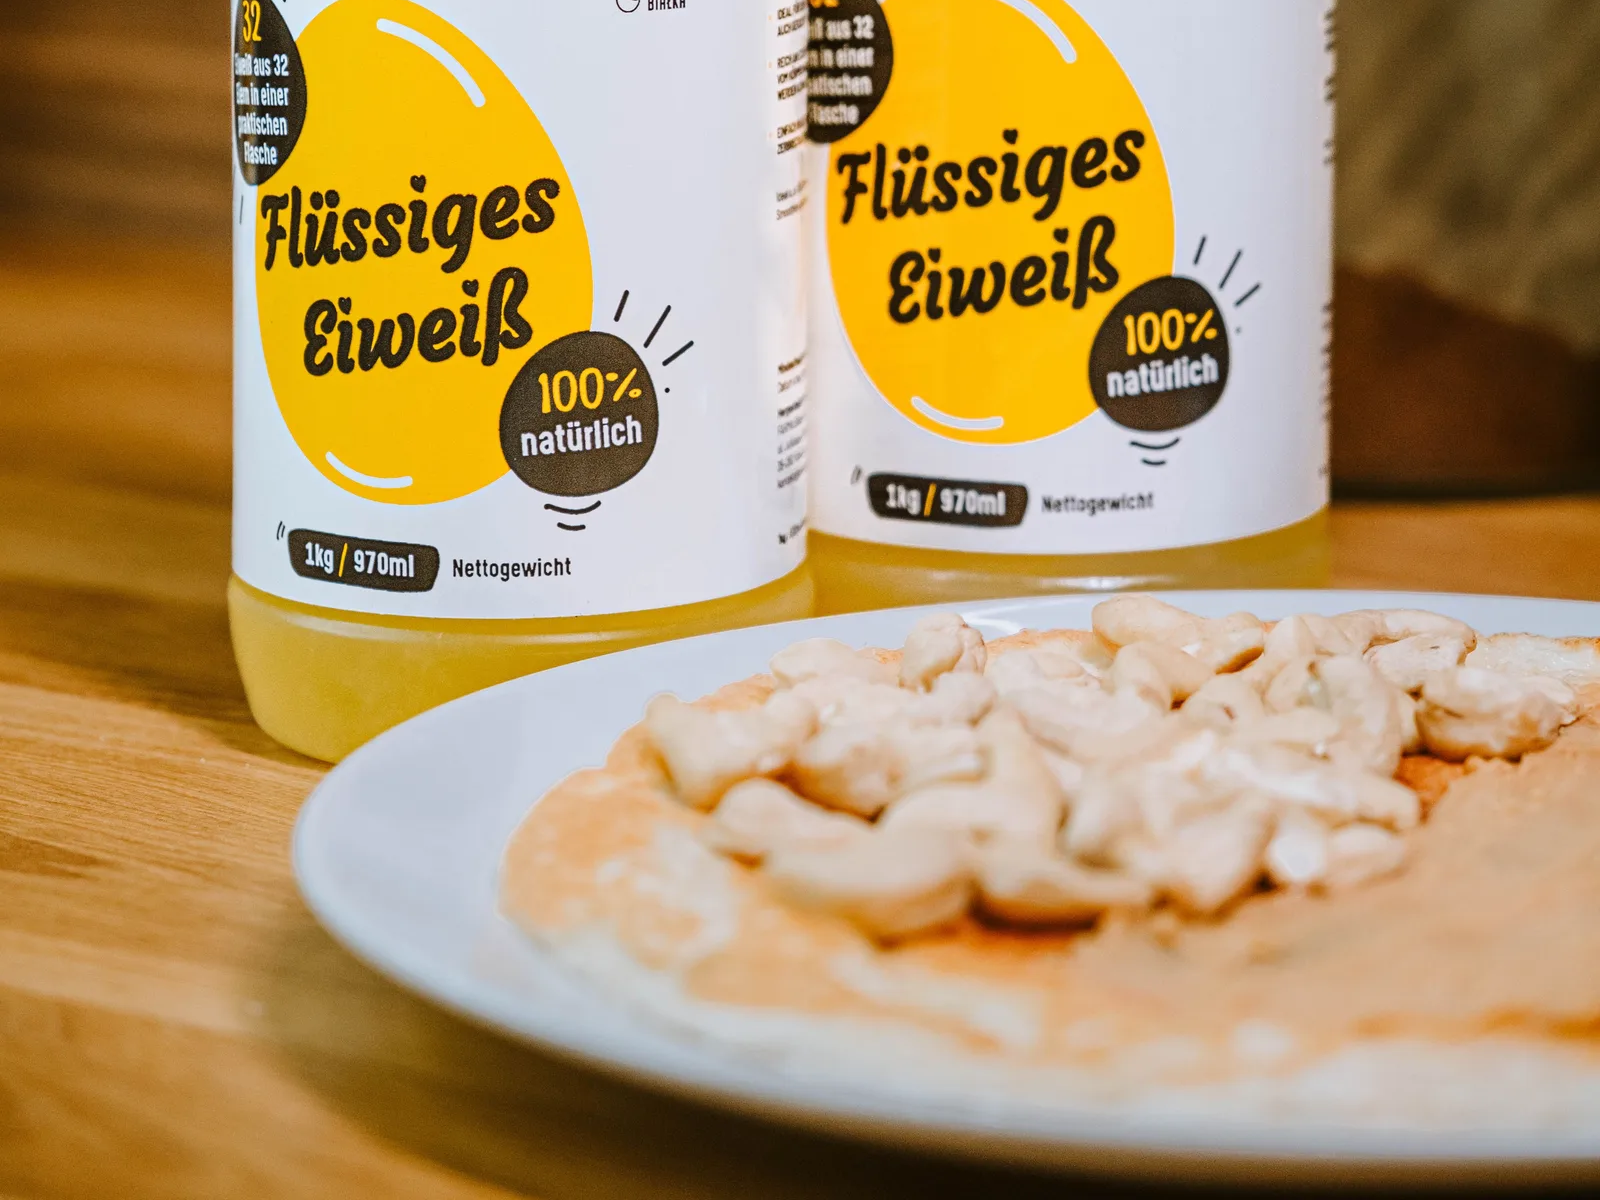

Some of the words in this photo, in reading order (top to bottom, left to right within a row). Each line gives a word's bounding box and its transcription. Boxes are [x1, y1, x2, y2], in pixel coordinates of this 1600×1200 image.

[242, 0, 262, 42] 32
[853, 14, 875, 40] 32
[254, 58, 272, 77] aus
[273, 53, 290, 77] 32
[250, 82, 260, 106] in
[261, 82, 289, 107] einer
[838, 129, 1146, 225] Flüssiges
[261, 175, 560, 274] Flüssiges
[888, 215, 1119, 325] Eiweiß
[303, 267, 533, 377] Eiweiß
[1124, 308, 1218, 356] 100%
[538, 367, 642, 414] 100%
[1106, 353, 1219, 398] natürlich
[520, 414, 643, 457] natürlich
[885, 482, 921, 515] 1kg
[940, 487, 1007, 517] 970ml
[304, 541, 334, 574] 1kg
[353, 549, 415, 578] 970ml
[452, 557, 572, 581] Nettogewicht
